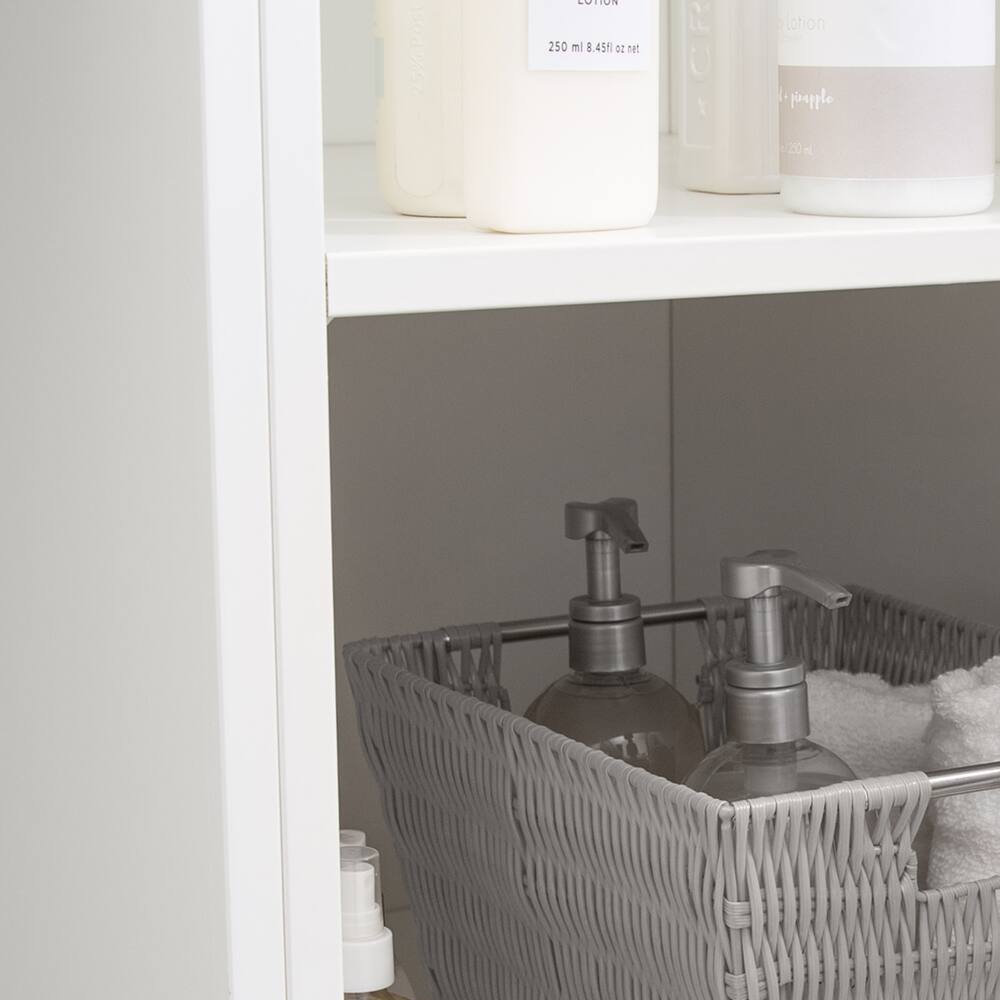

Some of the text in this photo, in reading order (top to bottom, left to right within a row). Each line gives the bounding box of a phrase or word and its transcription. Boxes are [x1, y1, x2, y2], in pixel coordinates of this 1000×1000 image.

[548, 40, 640, 54] 250 ml 8.45fl oz net
